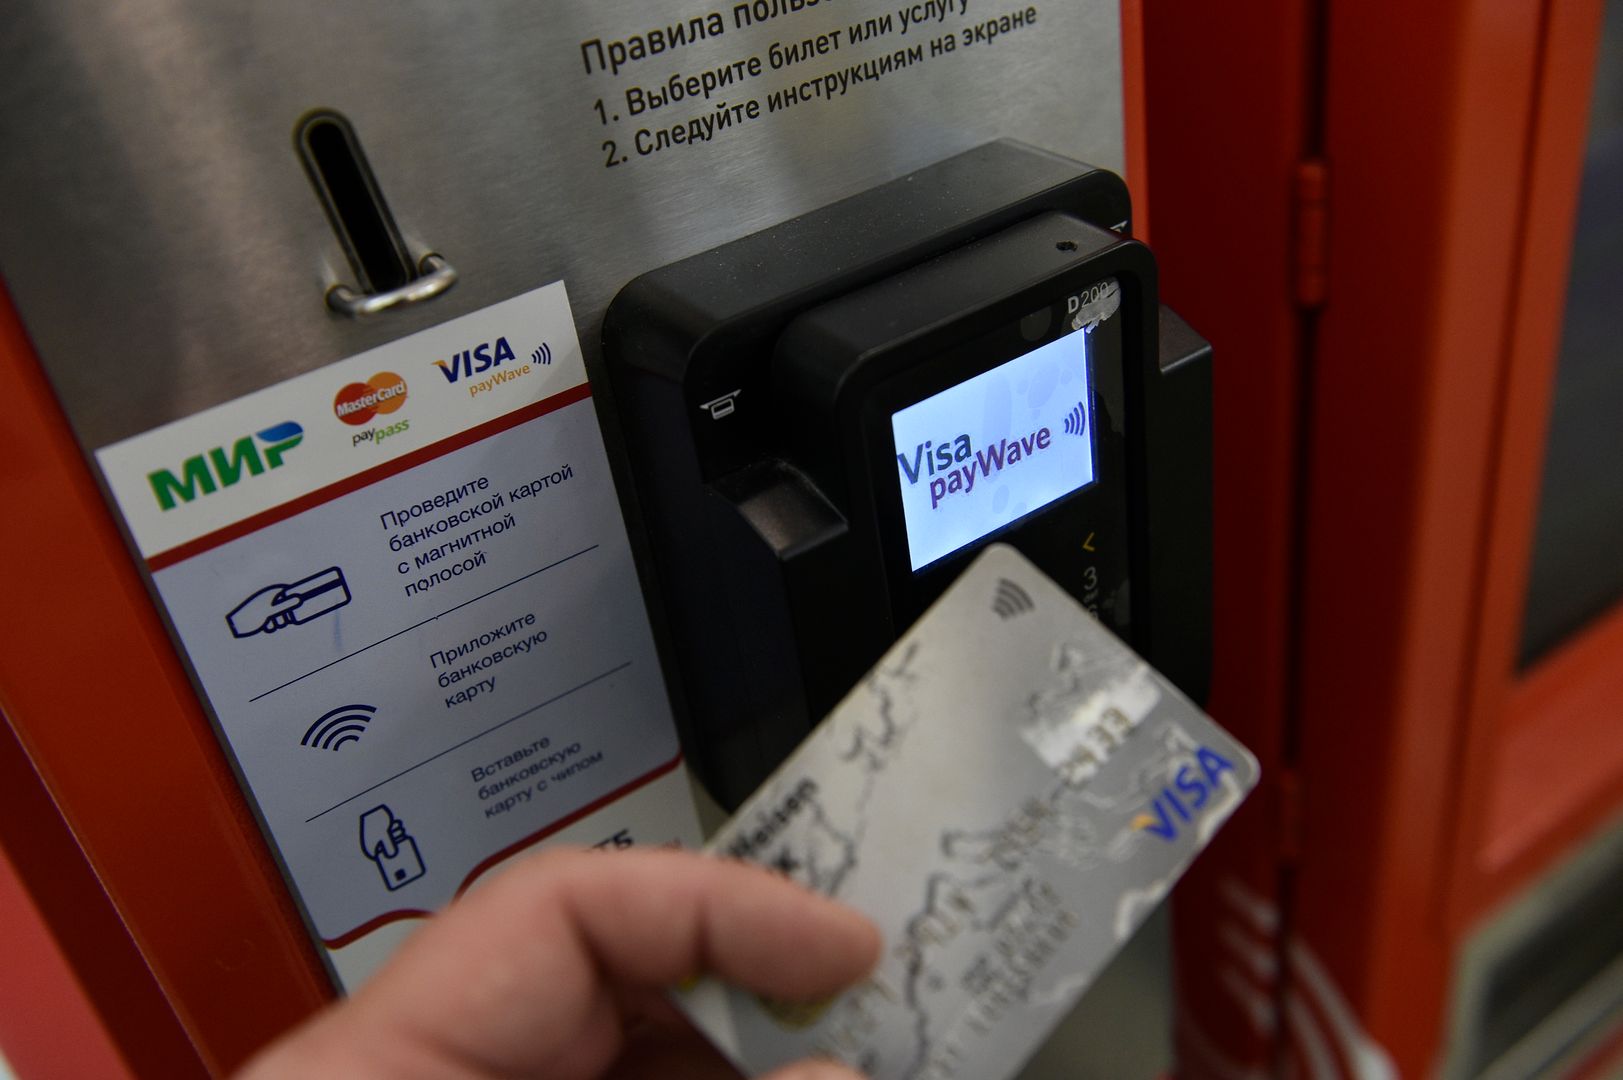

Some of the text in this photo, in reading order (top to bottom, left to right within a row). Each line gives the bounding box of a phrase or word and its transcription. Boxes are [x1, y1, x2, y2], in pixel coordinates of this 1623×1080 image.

[580, 12, 725, 75] Правила
[593, 98, 620, 125] 1.
[626, 56, 762, 116] Выберите
[768, 30, 841, 69] билет
[849, 14, 893, 44] или
[602, 6, 1037, 168] 2. Следуйте инструкциям на экране
[431, 336, 516, 384] VISA
[469, 364, 531, 397] payWave
[336, 380, 405, 417] MasterCard
[147, 420, 304, 512] МИР
[897, 433, 972, 484] Visa
[929, 427, 1051, 510] payWave
[380, 476, 489, 530] Проведите
[389, 463, 574, 552] банковской картой
[397, 512, 516, 574] с магнитной
[404, 550, 487, 597] полосой
[429, 612, 536, 668] Приложите
[437, 630, 548, 688] банковскую
[444, 676, 496, 709] карту
[471, 736, 550, 782] Вставьте
[478, 741, 582, 800] банковскую
[484, 751, 604, 819] карту с чипом
[1130, 746, 1234, 842] VISA
